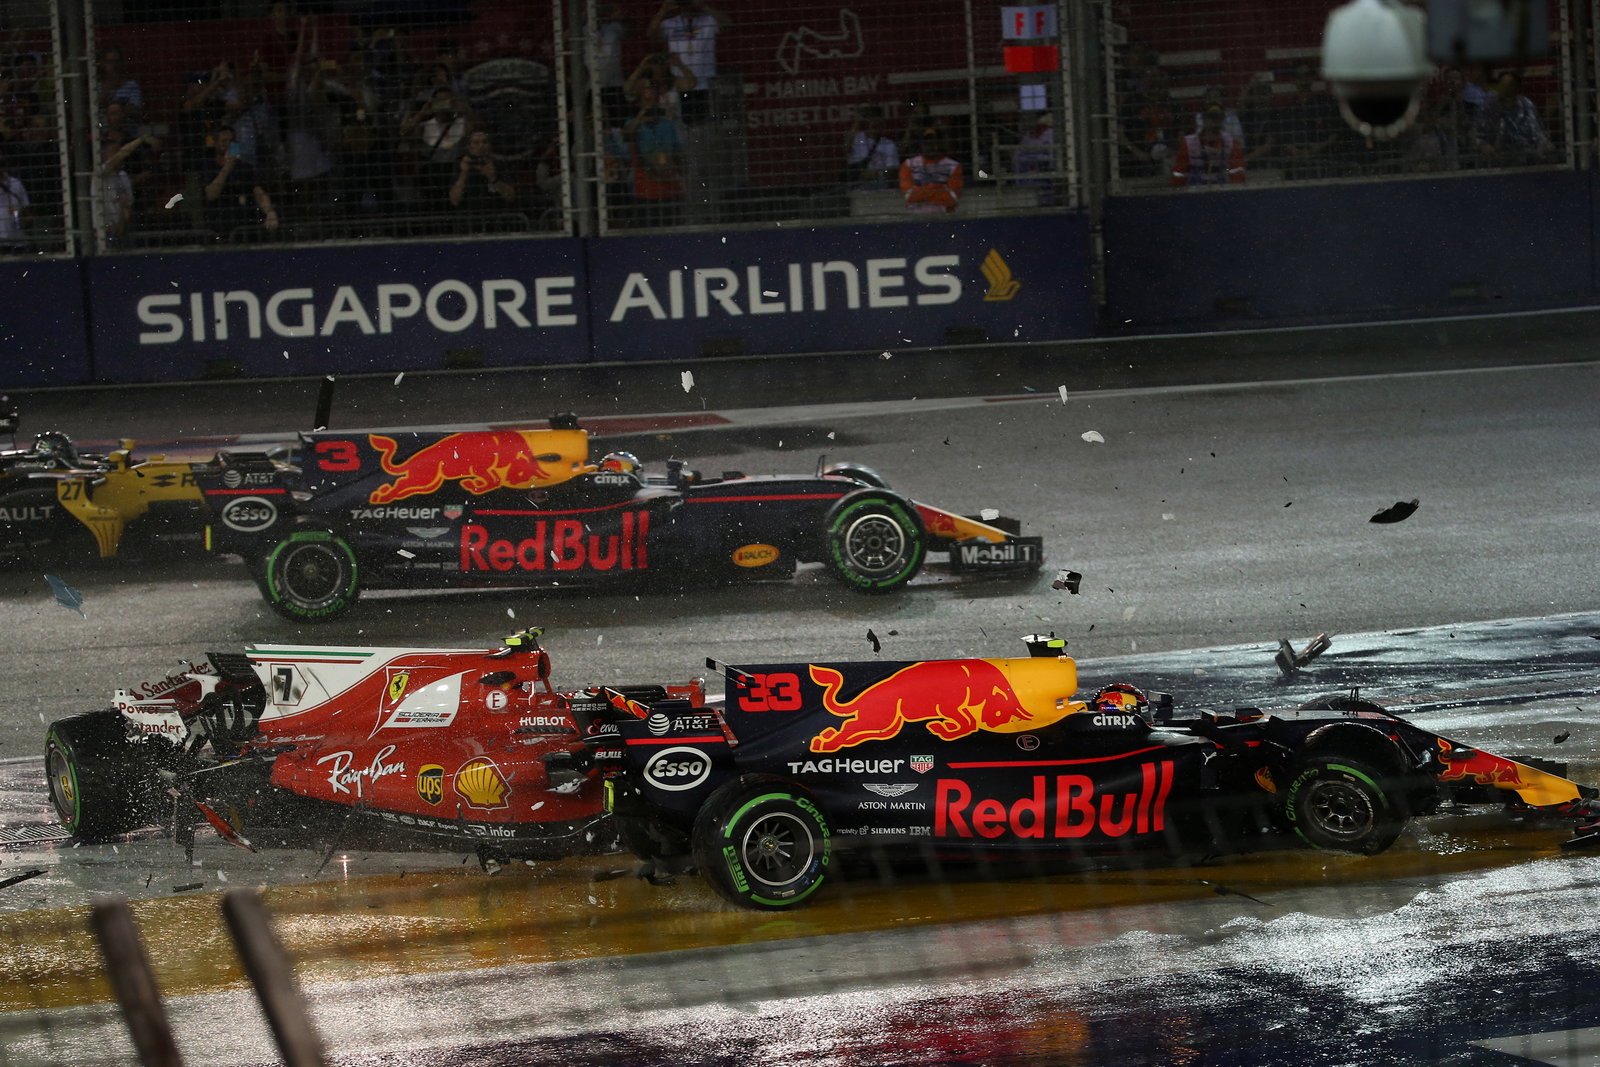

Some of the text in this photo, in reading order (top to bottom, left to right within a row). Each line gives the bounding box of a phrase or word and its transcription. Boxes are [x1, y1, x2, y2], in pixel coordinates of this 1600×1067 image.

[843, 75, 880, 95] BAY
[746, 105, 822, 128] STREET
[137, 255, 963, 345] SINGAPORE AIRLINES
[315, 440, 361, 471] 3
[243, 473, 276, 486] AT&T
[61, 482, 82, 501] 27
[140, 661, 213, 699] Santander
[276, 667, 293, 702] 7
[492, 692, 501, 708] E
[736, 672, 803, 712] 33
[519, 716, 566, 726] HUBLOT
[673, 716, 713, 731] AT&T
[420, 776, 441, 800] ups
[857, 801, 926, 811] ASTON MARTIN
[489, 826, 516, 838] infor
[871, 827, 906, 835] SIEMENS
[909, 826, 931, 836] IBM
